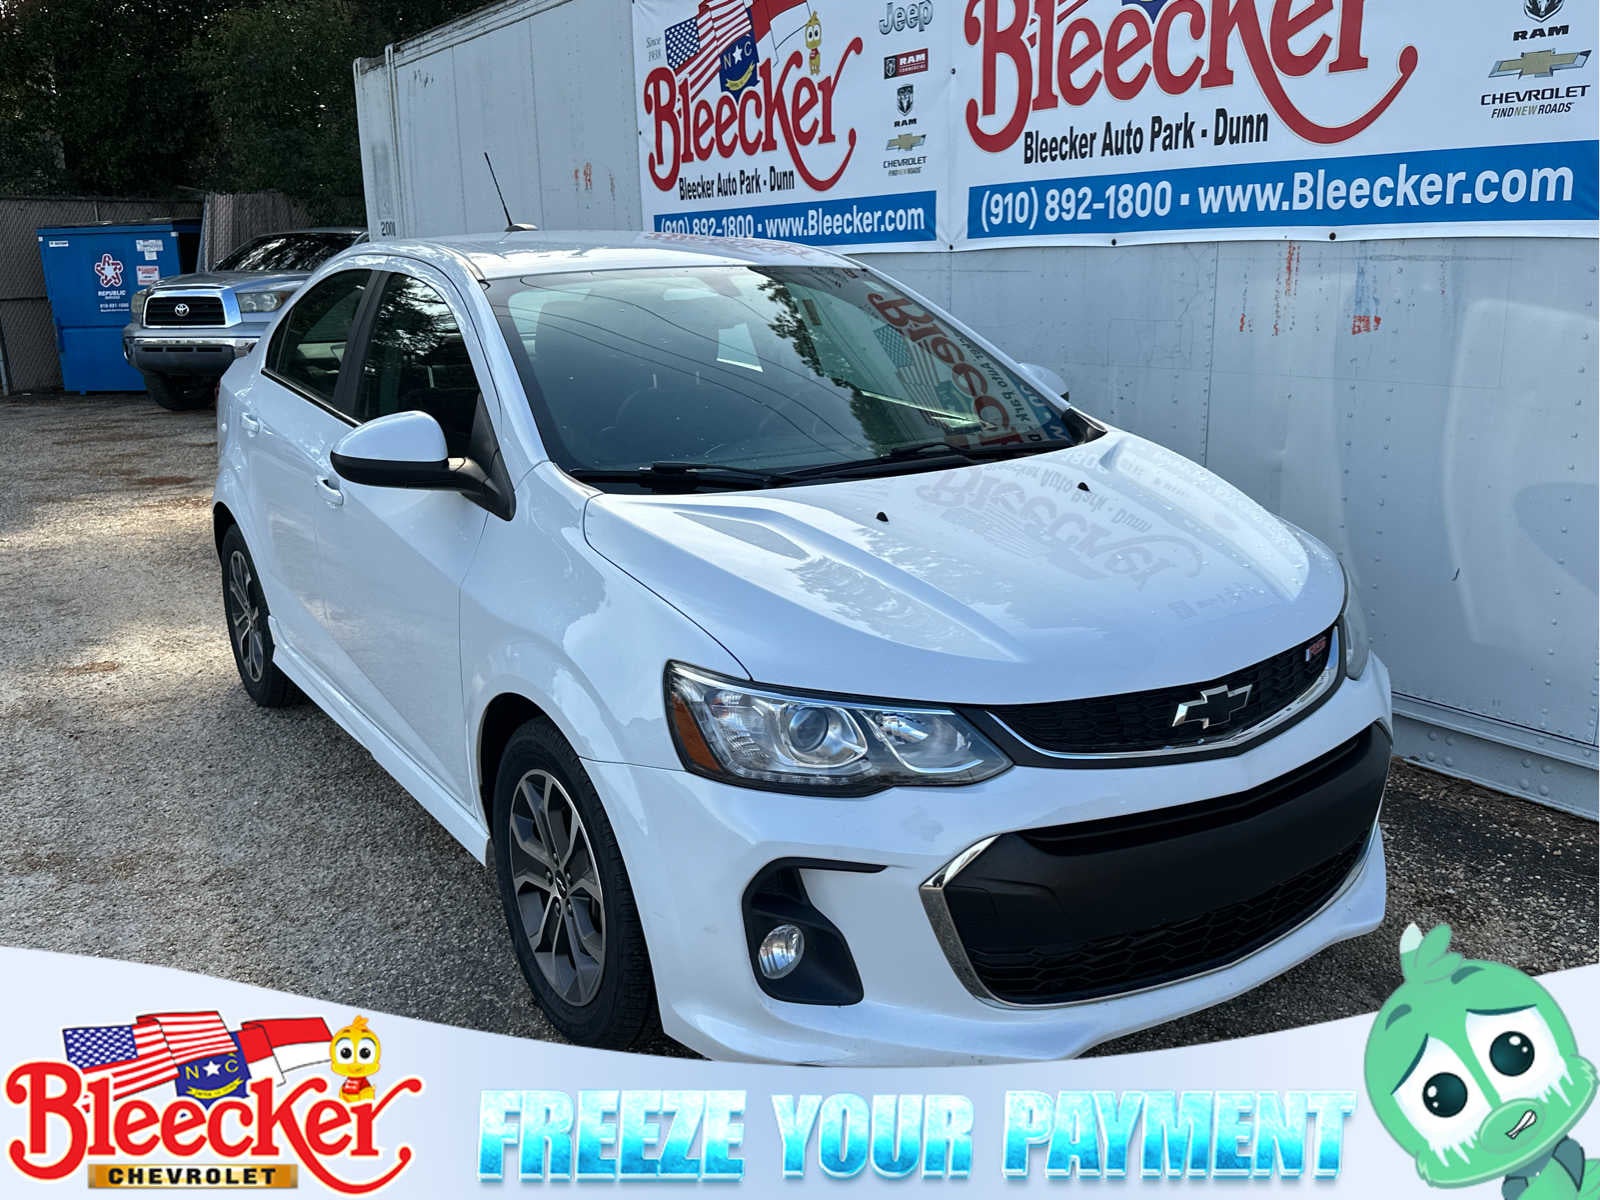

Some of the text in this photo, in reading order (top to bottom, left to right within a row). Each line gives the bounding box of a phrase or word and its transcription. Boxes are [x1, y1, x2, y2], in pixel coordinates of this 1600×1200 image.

[879, 0, 933, 35] Jeep
[1512, 24, 1569, 41] RAM
[899, 53, 926, 66] RAM
[964, 0, 1419, 152] Bleecker
[1480, 84, 1591, 106] CHEVROLET
[643, 36, 864, 192] Bleecker
[894, 118, 918, 127] RAM
[1023, 108, 1269, 165] Bleecker Auto Park Dunn
[883, 155, 927, 169] CHEVROLET
[678, 166, 795, 201] Bleecker Auto Park Dunn
[981, 163, 1574, 233] (910) 892-1800 www.Bleecker.com
[765, 205, 925, 238] www.Bleecker.com
